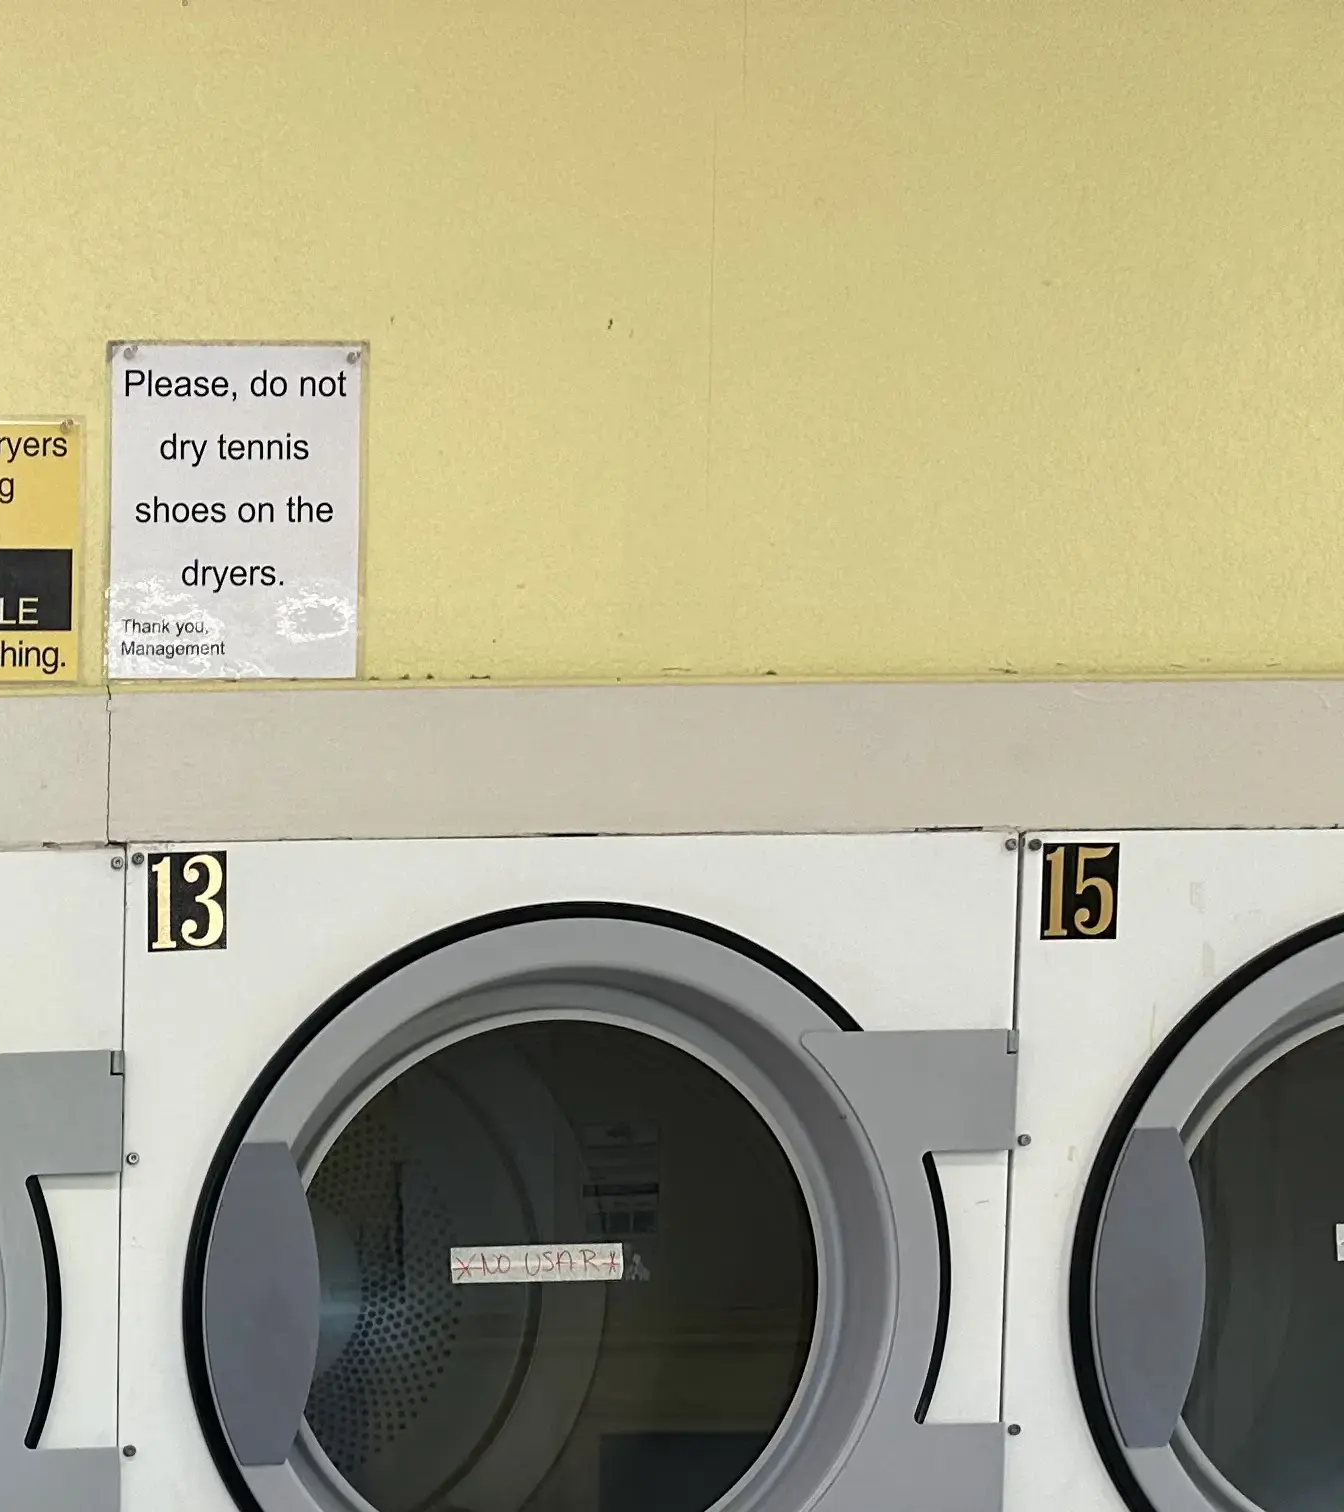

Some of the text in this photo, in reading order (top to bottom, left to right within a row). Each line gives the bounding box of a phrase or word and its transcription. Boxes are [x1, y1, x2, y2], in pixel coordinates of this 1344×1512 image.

[124, 369, 347, 401] Please, do not
[160, 432, 310, 468] dry tennis
[135, 495, 334, 523] shoes on the
[181, 558, 285, 594] dryers.
[121, 619, 209, 636] Thank you,
[121, 641, 225, 659] Management
[151, 854, 224, 950] 13
[1043, 846, 1114, 936] 15
[480, 1248, 600, 1277] NO USAR
